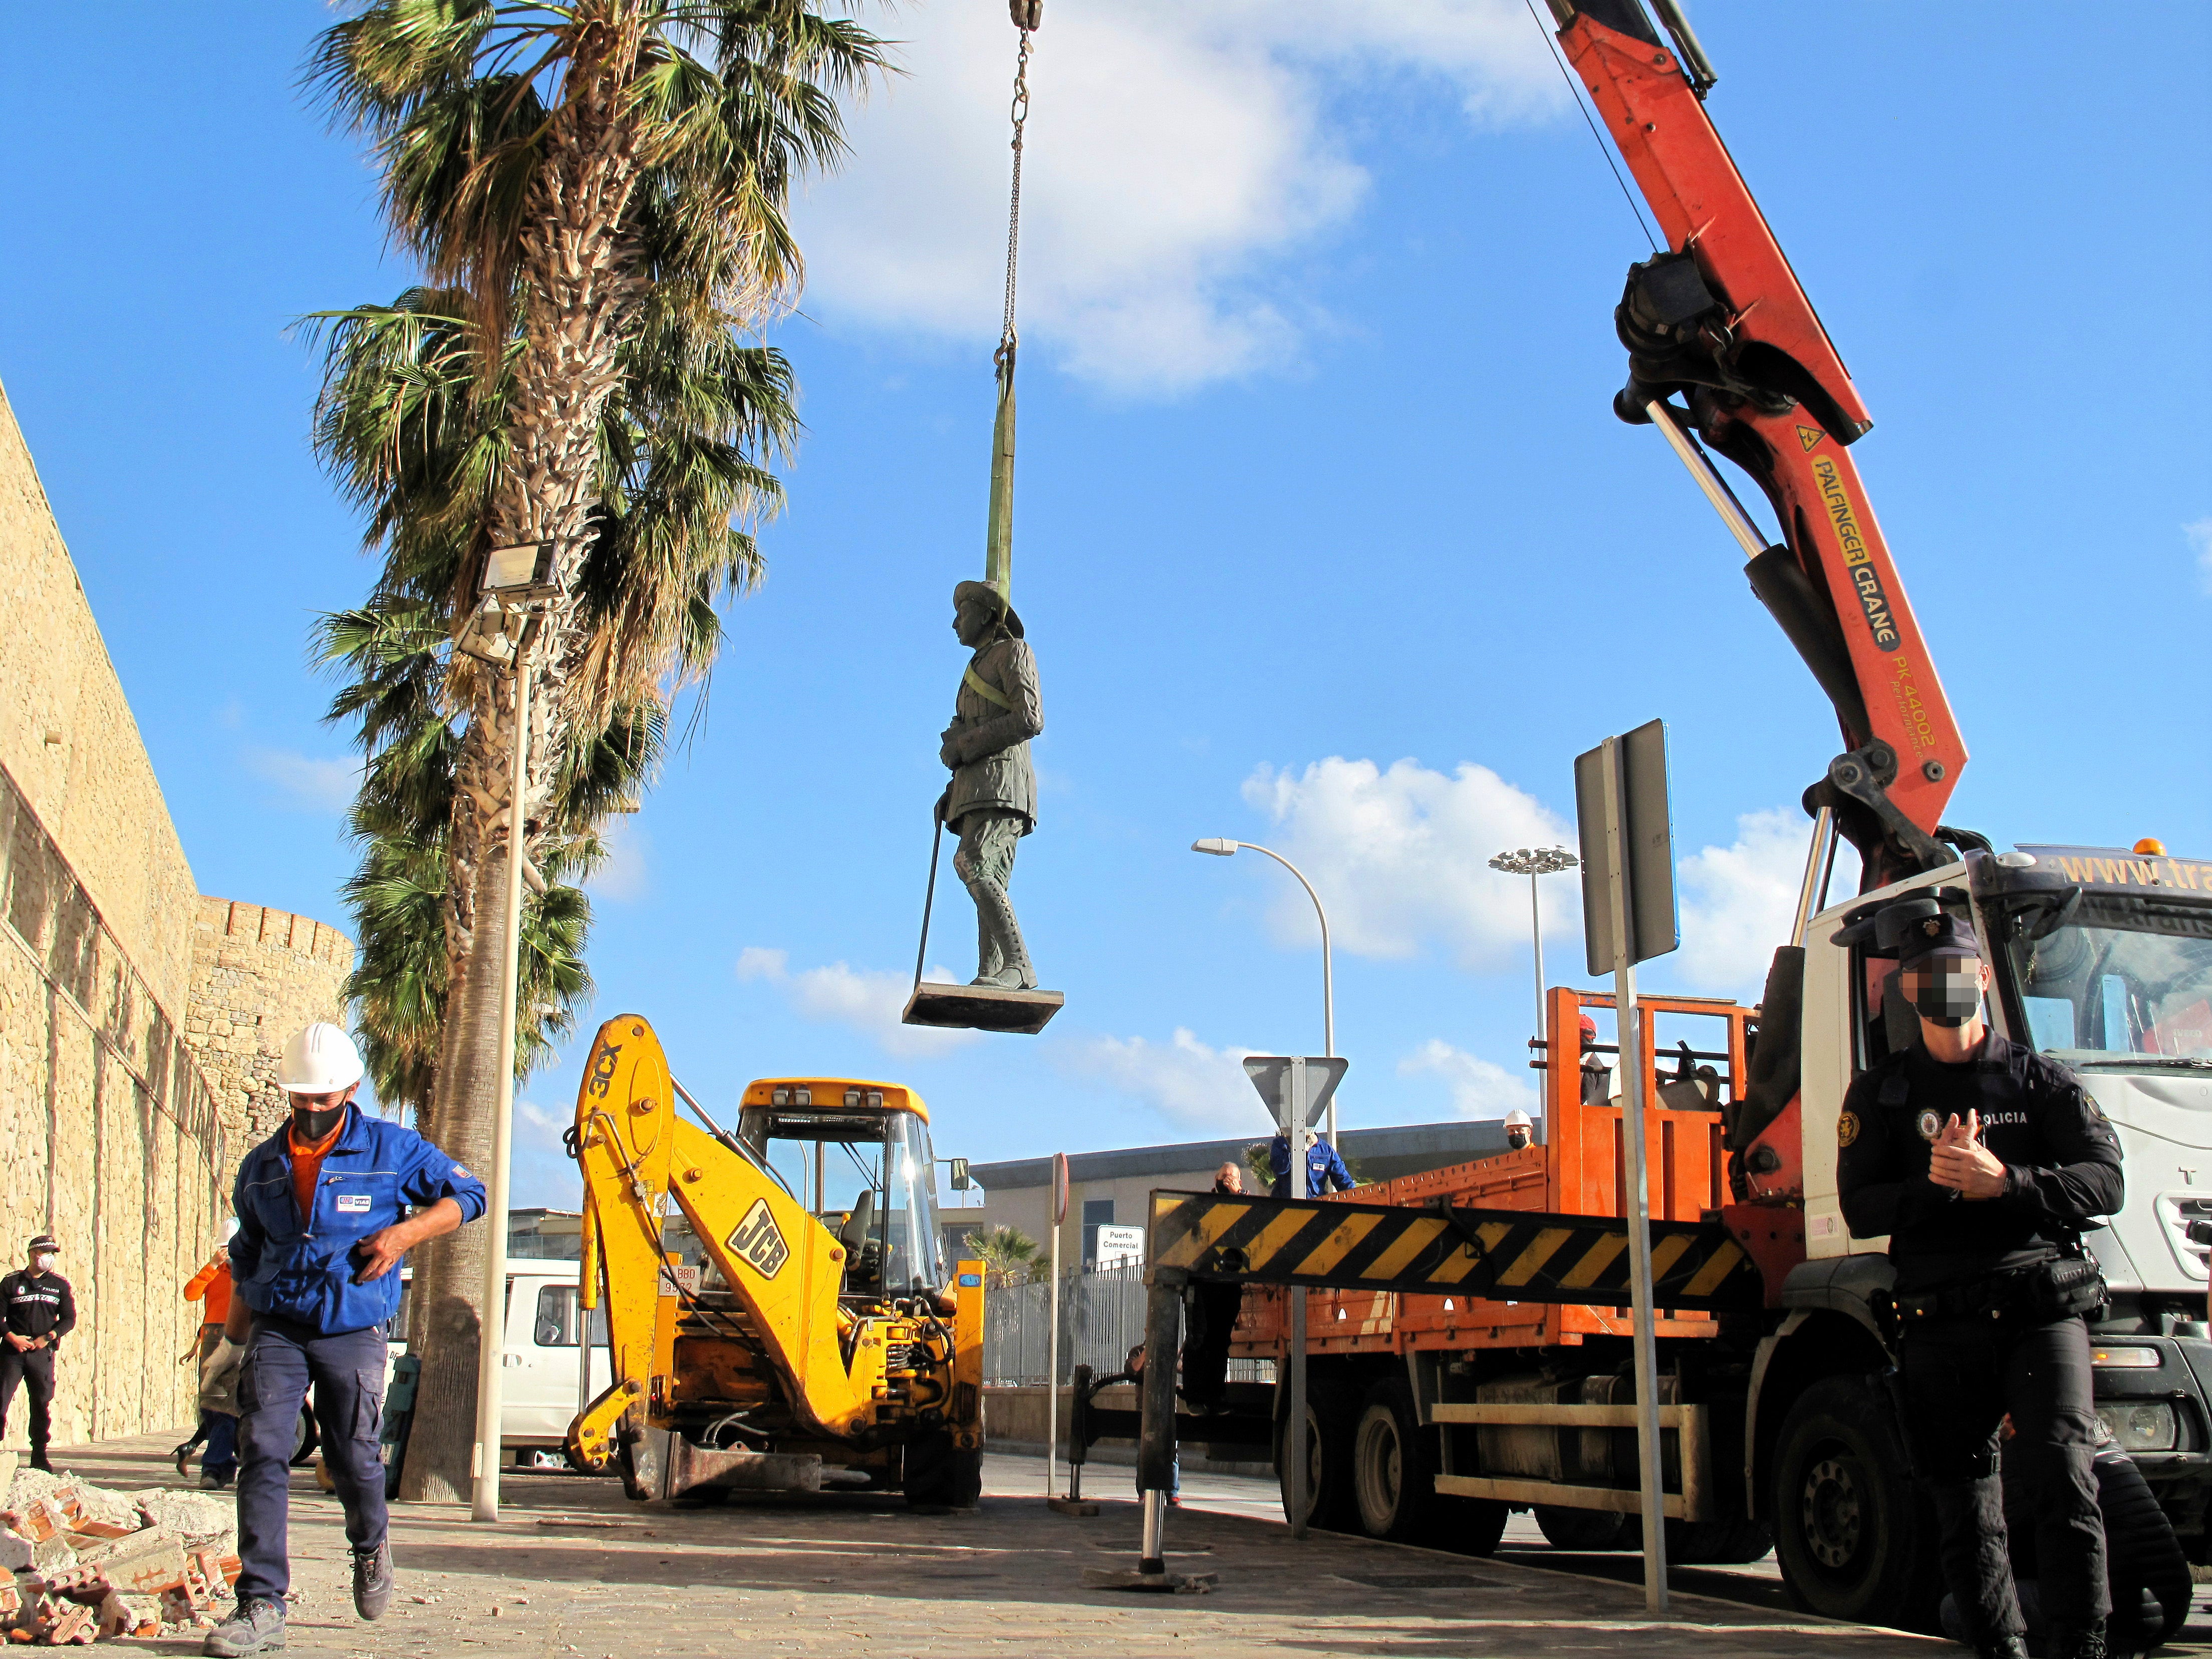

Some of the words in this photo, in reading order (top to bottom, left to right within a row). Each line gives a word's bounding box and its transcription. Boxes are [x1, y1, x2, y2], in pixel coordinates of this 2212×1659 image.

[1816, 461, 1865, 562] PALFINGER
[1855, 568, 1895, 643] CRANE
[1890, 681, 1923, 758] Performance
[1893, 656, 1912, 680] PK
[1905, 685, 1936, 746] 44002
[589, 1039, 623, 1098] 3CX
[732, 1208, 785, 1273] JCB
[1103, 1241, 1139, 1249] Comercial
